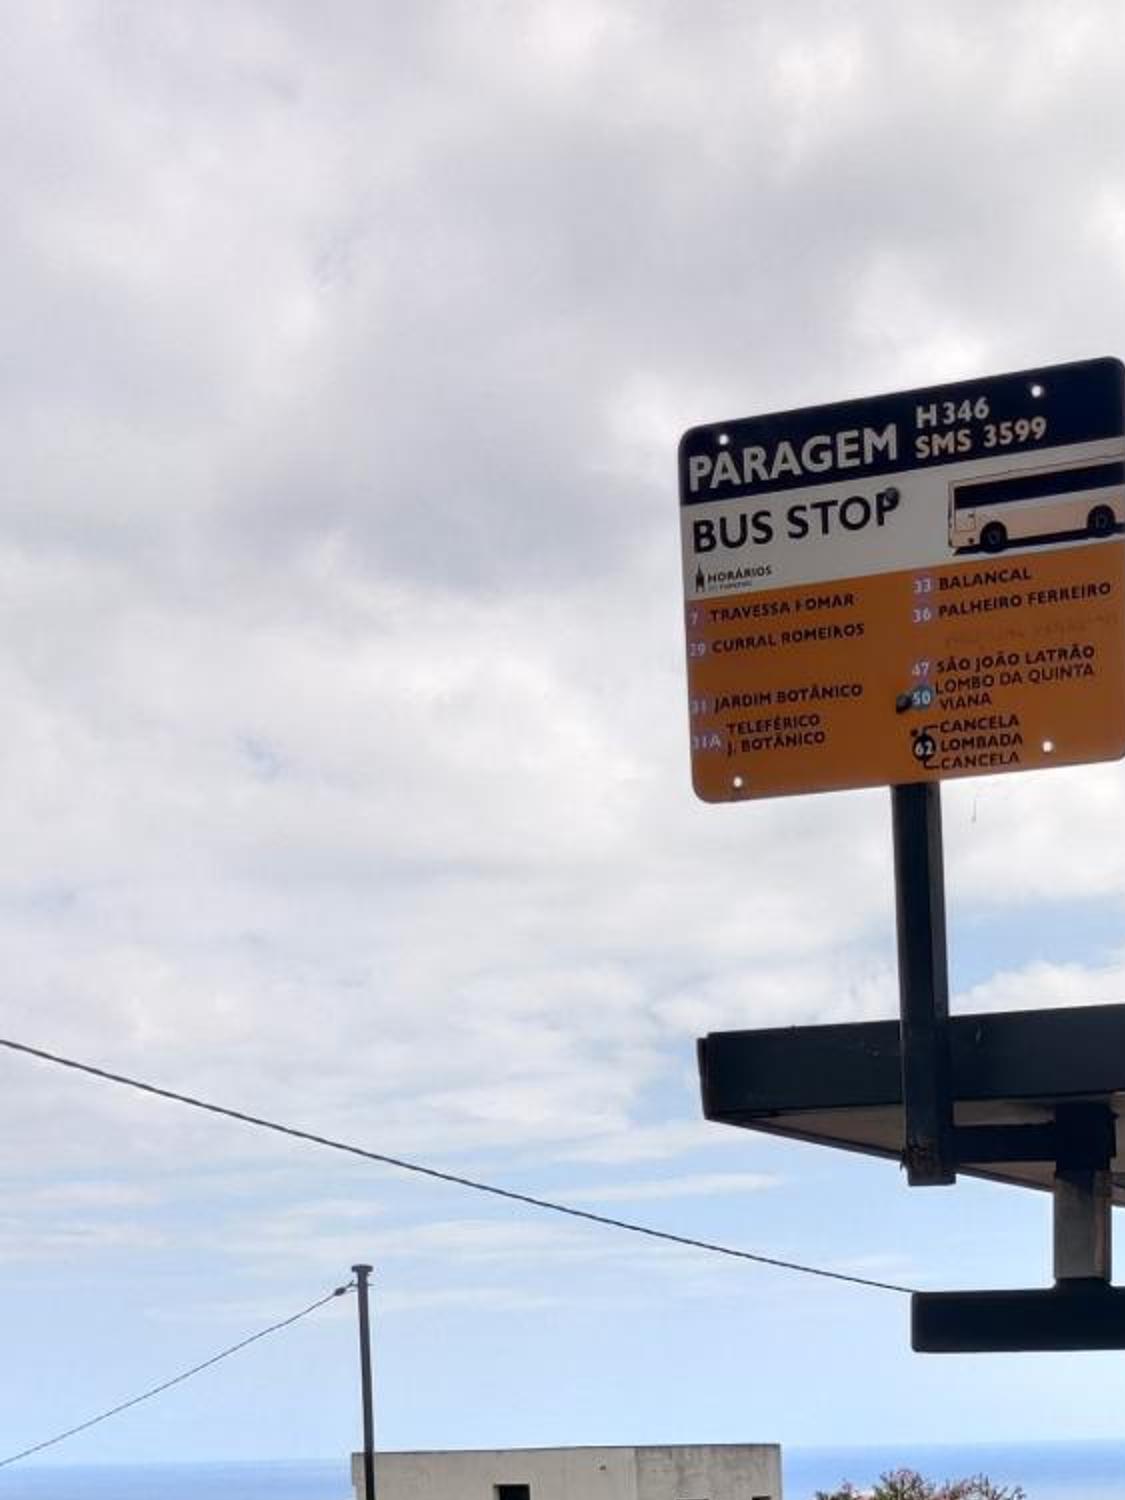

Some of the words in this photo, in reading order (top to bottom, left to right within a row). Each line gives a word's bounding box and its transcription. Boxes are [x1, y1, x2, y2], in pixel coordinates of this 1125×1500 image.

[916, 405, 937, 429] H
[942, 397, 990, 425] 346
[914, 430, 972, 459] SMS
[983, 416, 1047, 448] 3599
[688, 423, 898, 492] PARAGEM
[693, 510, 774, 553] BUS
[787, 487, 901, 539] STOP
[938, 568, 1032, 591] BALANCAL
[710, 602, 791, 622] TRAVESSA
[913, 608, 932, 623] 36
[938, 595, 1022, 617] PALHEIRO
[1027, 582, 1112, 605] FERREIRO
[711, 634, 777, 654] CURRAL
[781, 623, 865, 643] ROMEIROS
[936, 656, 970, 673] SÃO
[975, 651, 1020, 672] JOÃO
[1025, 643, 1095, 665] LATRÃO
[935, 674, 995, 695] LOMBO
[1000, 668, 1023, 685] DA
[1028, 663, 1095, 683] QUINTA
[714, 693, 772, 712] JARDIM
[777, 684, 863, 704] BOTÂNICO
[940, 692, 992, 711] VIANA
[726, 713, 821, 735] TELEFÉRICO
[940, 714, 1020, 733] CANCELA
[742, 731, 826, 752] BOTÂNICO
[941, 732, 1023, 752] LOMBADA
[941, 752, 1020, 770] CANCELA
